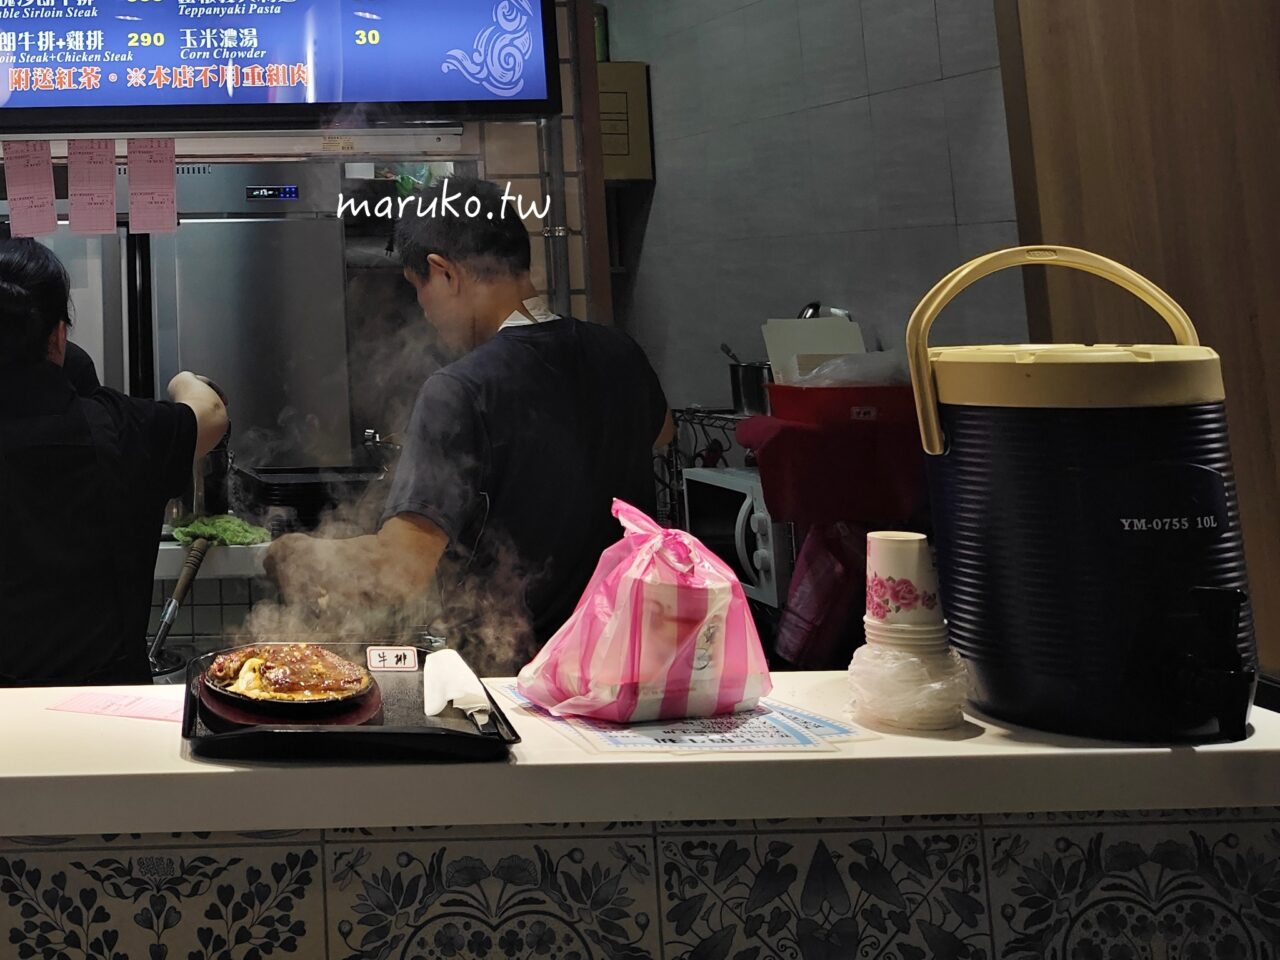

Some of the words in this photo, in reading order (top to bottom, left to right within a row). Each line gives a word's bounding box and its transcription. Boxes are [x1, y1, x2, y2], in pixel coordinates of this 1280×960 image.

[22, 7, 63, 19] Sirloin
[65, 6, 99, 18] Steak
[178, 3, 246, 18] Teppanyaki
[248, 3, 282, 15] Pasta
[127, 32, 165, 47] 290
[179, 27, 258, 49] 玉米濃湯
[354, 29, 380, 45] 30
[18, 51, 102, 64] Steak+Chicken
[103, 50, 134, 62] Steak
[180, 48, 210, 60] Corn
[213, 47, 267, 59] Chowder
[1119, 516, 1189, 531] YM-0755
[1196, 515, 1218, 529] 10L
